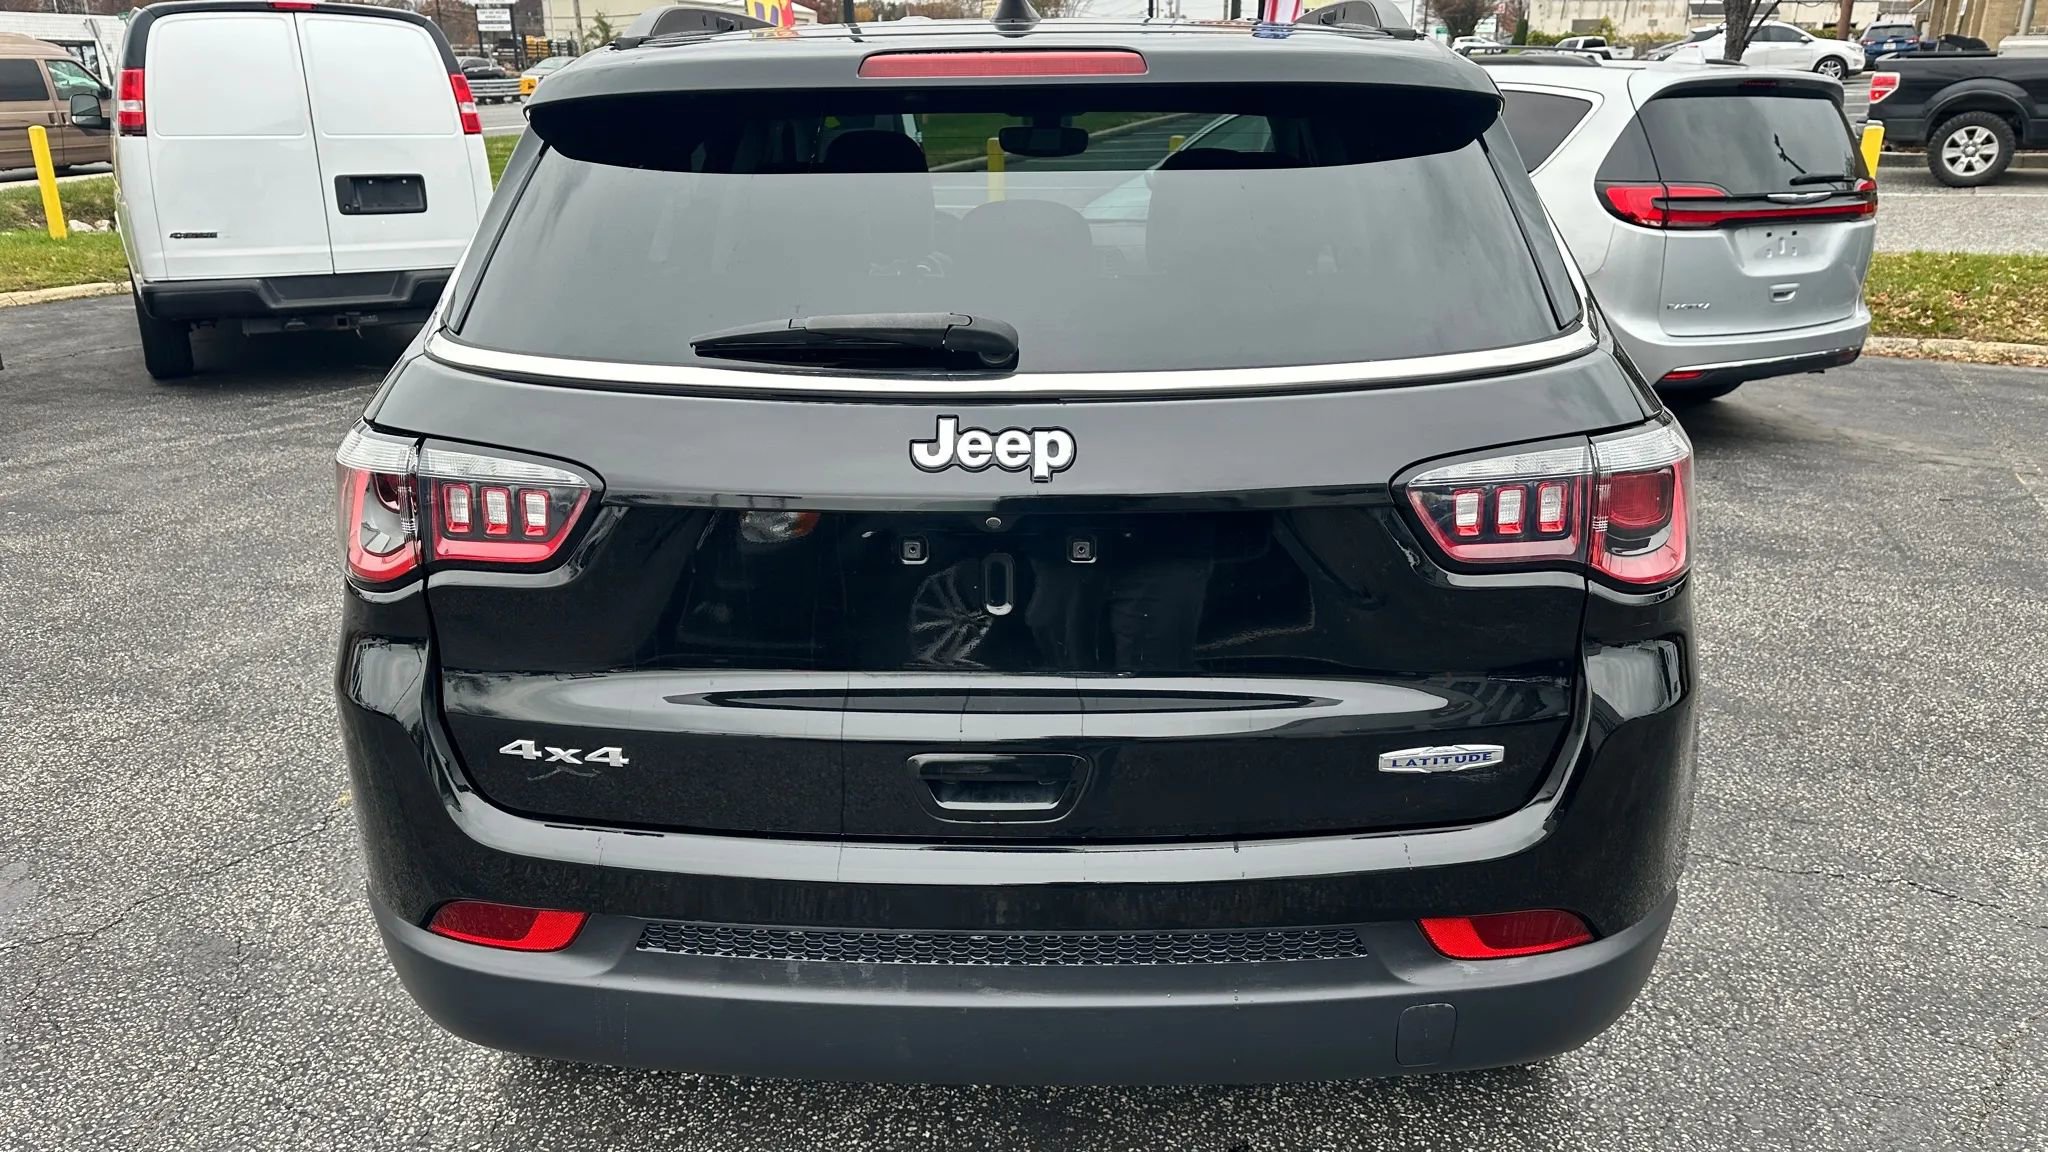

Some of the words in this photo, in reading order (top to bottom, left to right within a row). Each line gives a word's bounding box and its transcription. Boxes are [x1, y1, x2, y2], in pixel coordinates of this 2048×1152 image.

[911, 415, 1076, 482] Jeep
[499, 739, 630, 767] 4x4
[1391, 752, 1493, 768] LATITUDE
